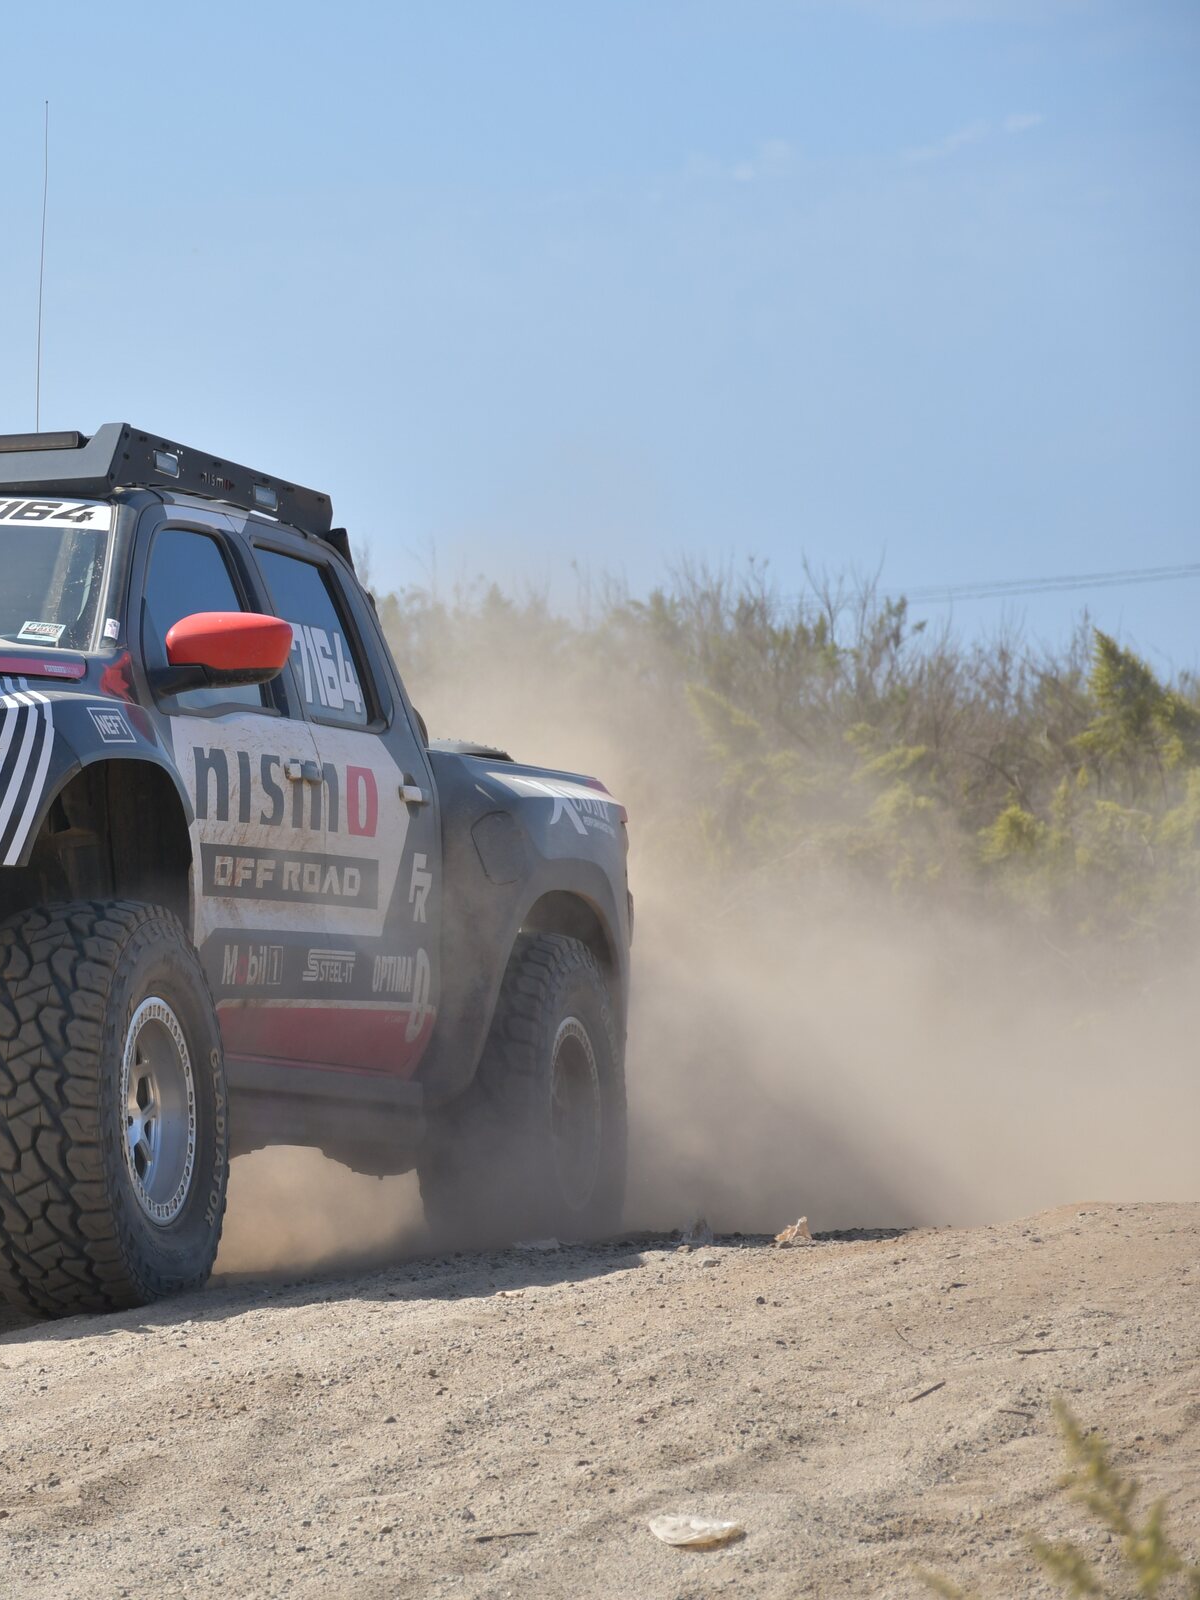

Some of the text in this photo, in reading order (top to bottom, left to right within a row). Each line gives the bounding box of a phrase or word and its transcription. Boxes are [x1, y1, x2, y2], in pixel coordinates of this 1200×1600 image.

[290, 622, 362, 713] 7164
[94, 714, 128, 735] NEFT
[213, 855, 361, 897] OFF ROAD
[221, 945, 268, 985] Mobil
[372, 955, 414, 993] OPTIMA
[205, 1047, 226, 1228] GLADIATOR
